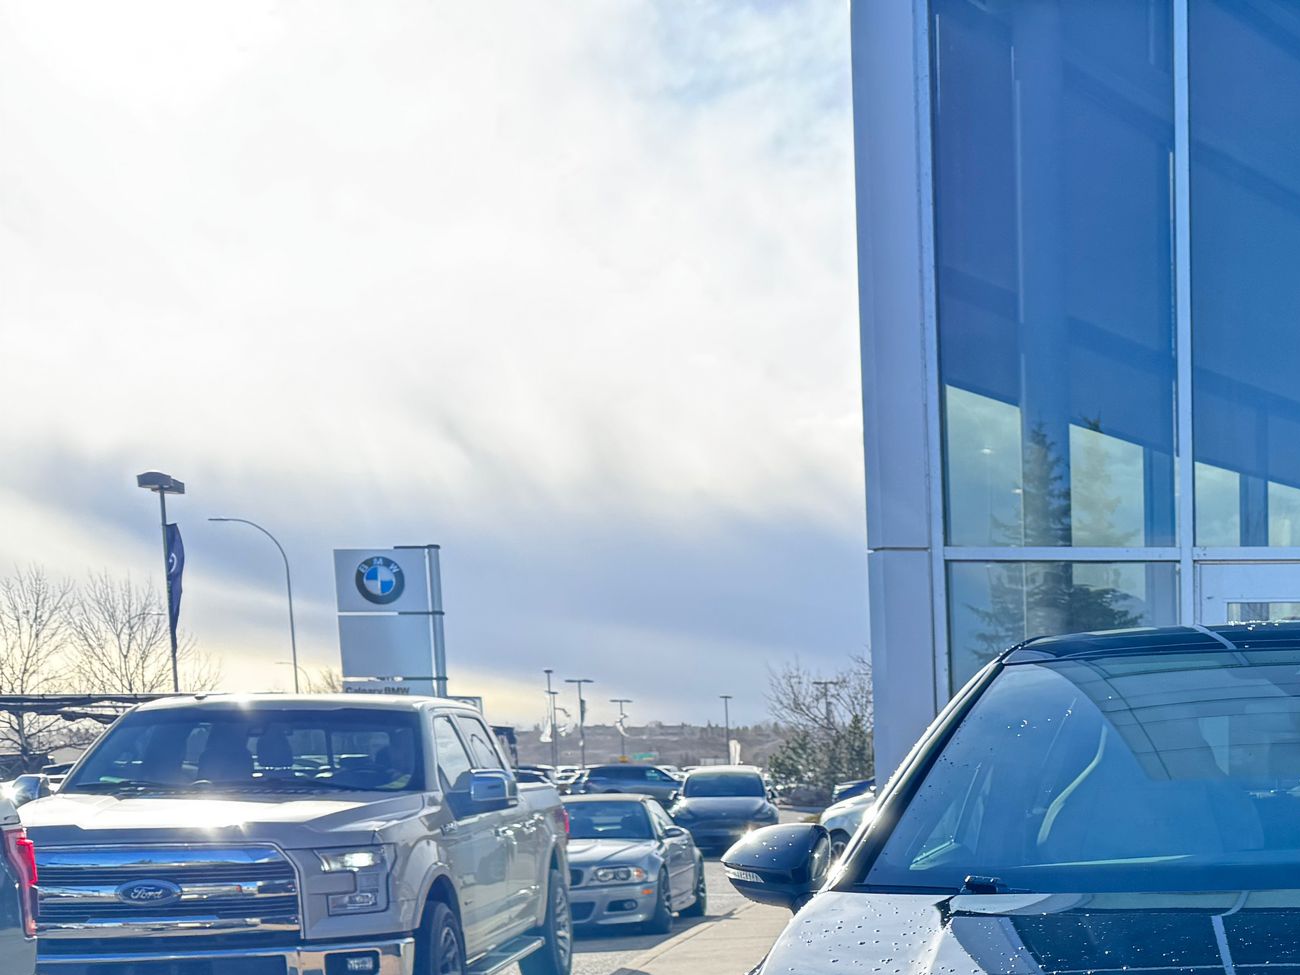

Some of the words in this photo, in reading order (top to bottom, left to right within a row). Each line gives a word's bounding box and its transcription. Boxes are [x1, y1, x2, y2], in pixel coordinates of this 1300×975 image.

[359, 557, 401, 573] BMW
[384, 686, 410, 695] BMW
[130, 886, 164, 899] Ford
